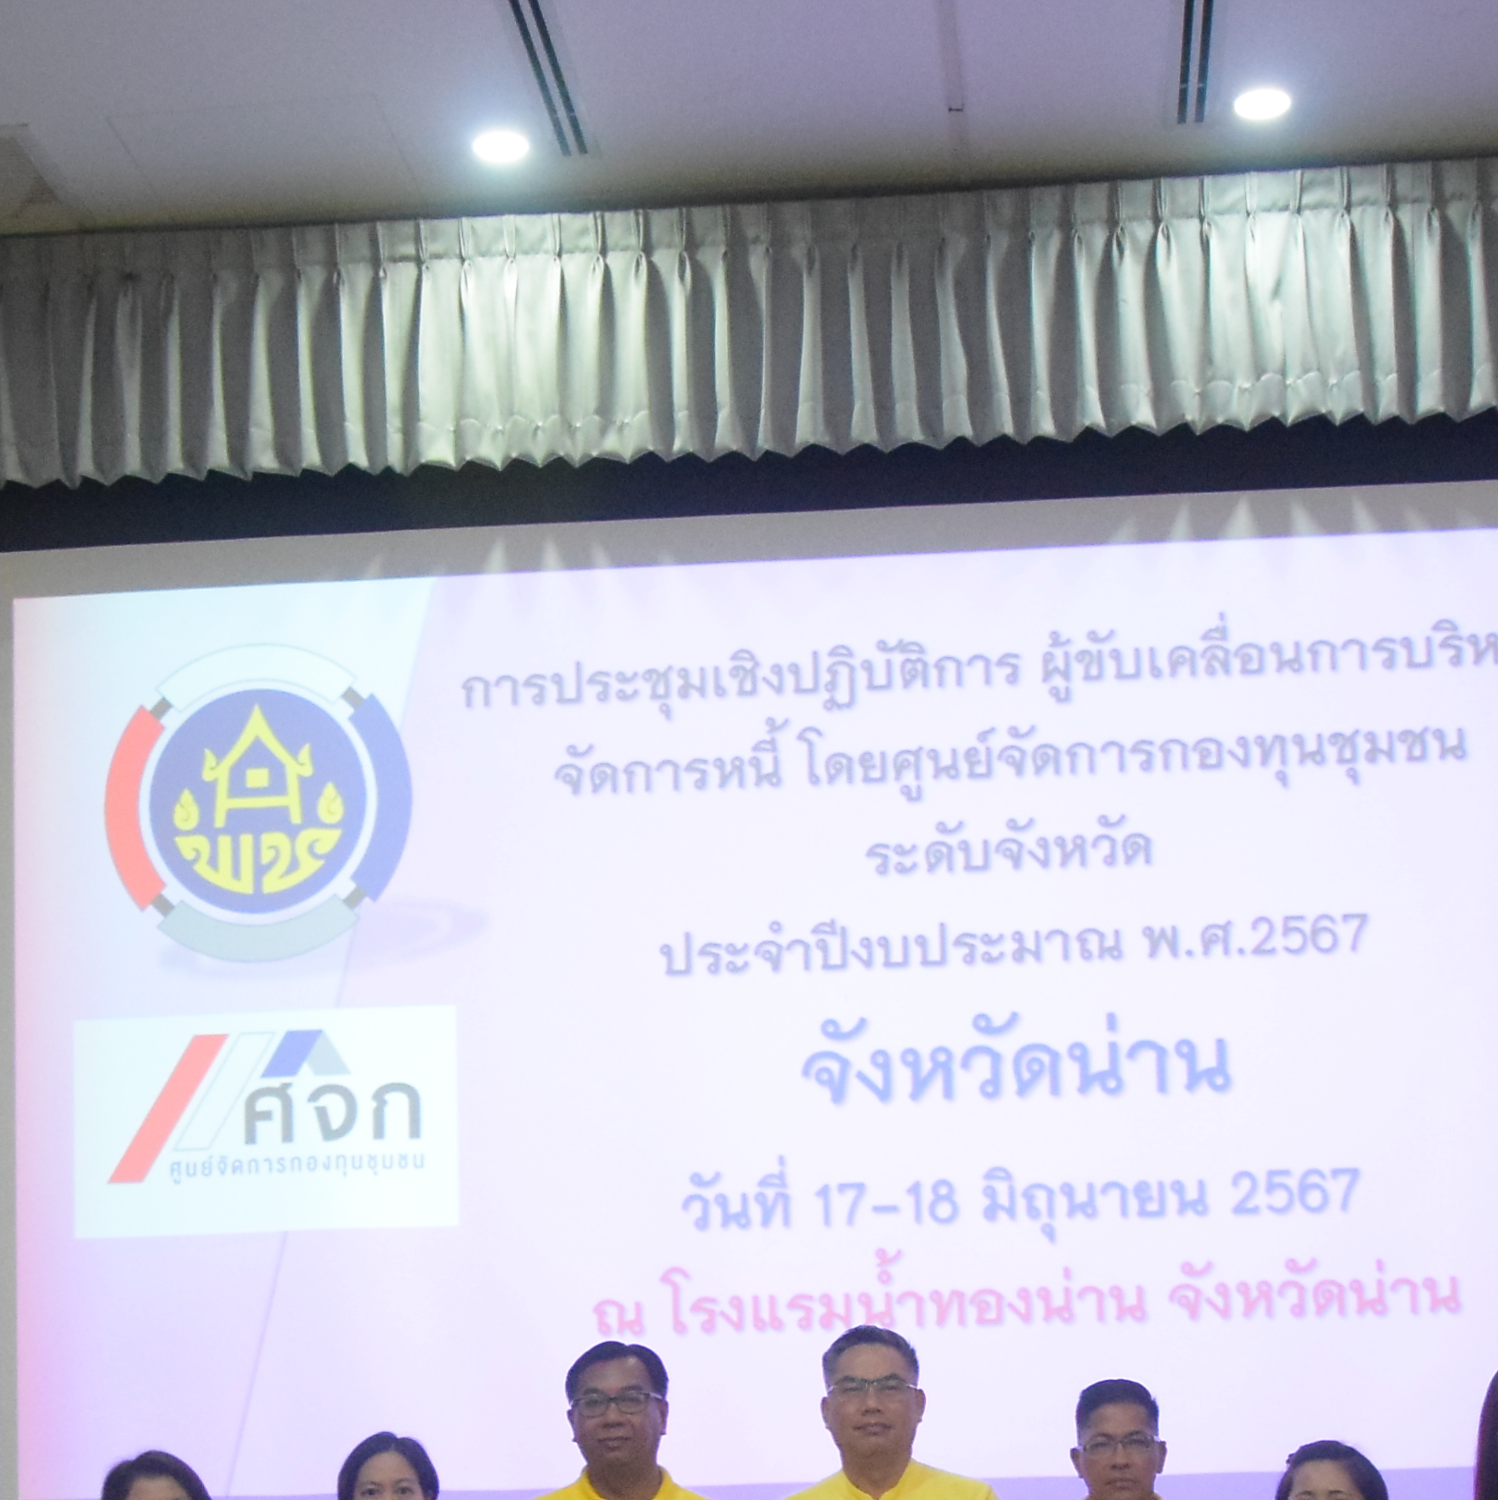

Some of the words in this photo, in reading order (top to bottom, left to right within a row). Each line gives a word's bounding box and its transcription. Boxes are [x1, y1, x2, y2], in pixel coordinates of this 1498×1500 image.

[461, 640, 1022, 719] การประชุมเชิงปฏิบัติการ
[552, 718, 787, 797] จัดการหนี้
[796, 719, 1469, 801] โดยศูนย์จัดการกองทุนชุมชน
[864, 814, 1154, 877] ระดับจังหวัด
[659, 918, 1124, 977] ประจำปีงบประมาณ
[1142, 912, 1370, 960] พ.ศ.2567
[801, 1011, 1233, 1106] จังหวัดน่าน
[244, 1082, 422, 1145] ศจก
[681, 1155, 792, 1232] วันที่
[815, 1178, 961, 1228] 17-18
[982, 1166, 1210, 1244] มิถุนายน
[1231, 1167, 1362, 1217] 2567
[593, 1299, 646, 1337] ณ
[659, 1246, 1148, 1336] โรงแรมน้ำทองน่าน
[1168, 1257, 1463, 1322] จังหวัดน่าน
